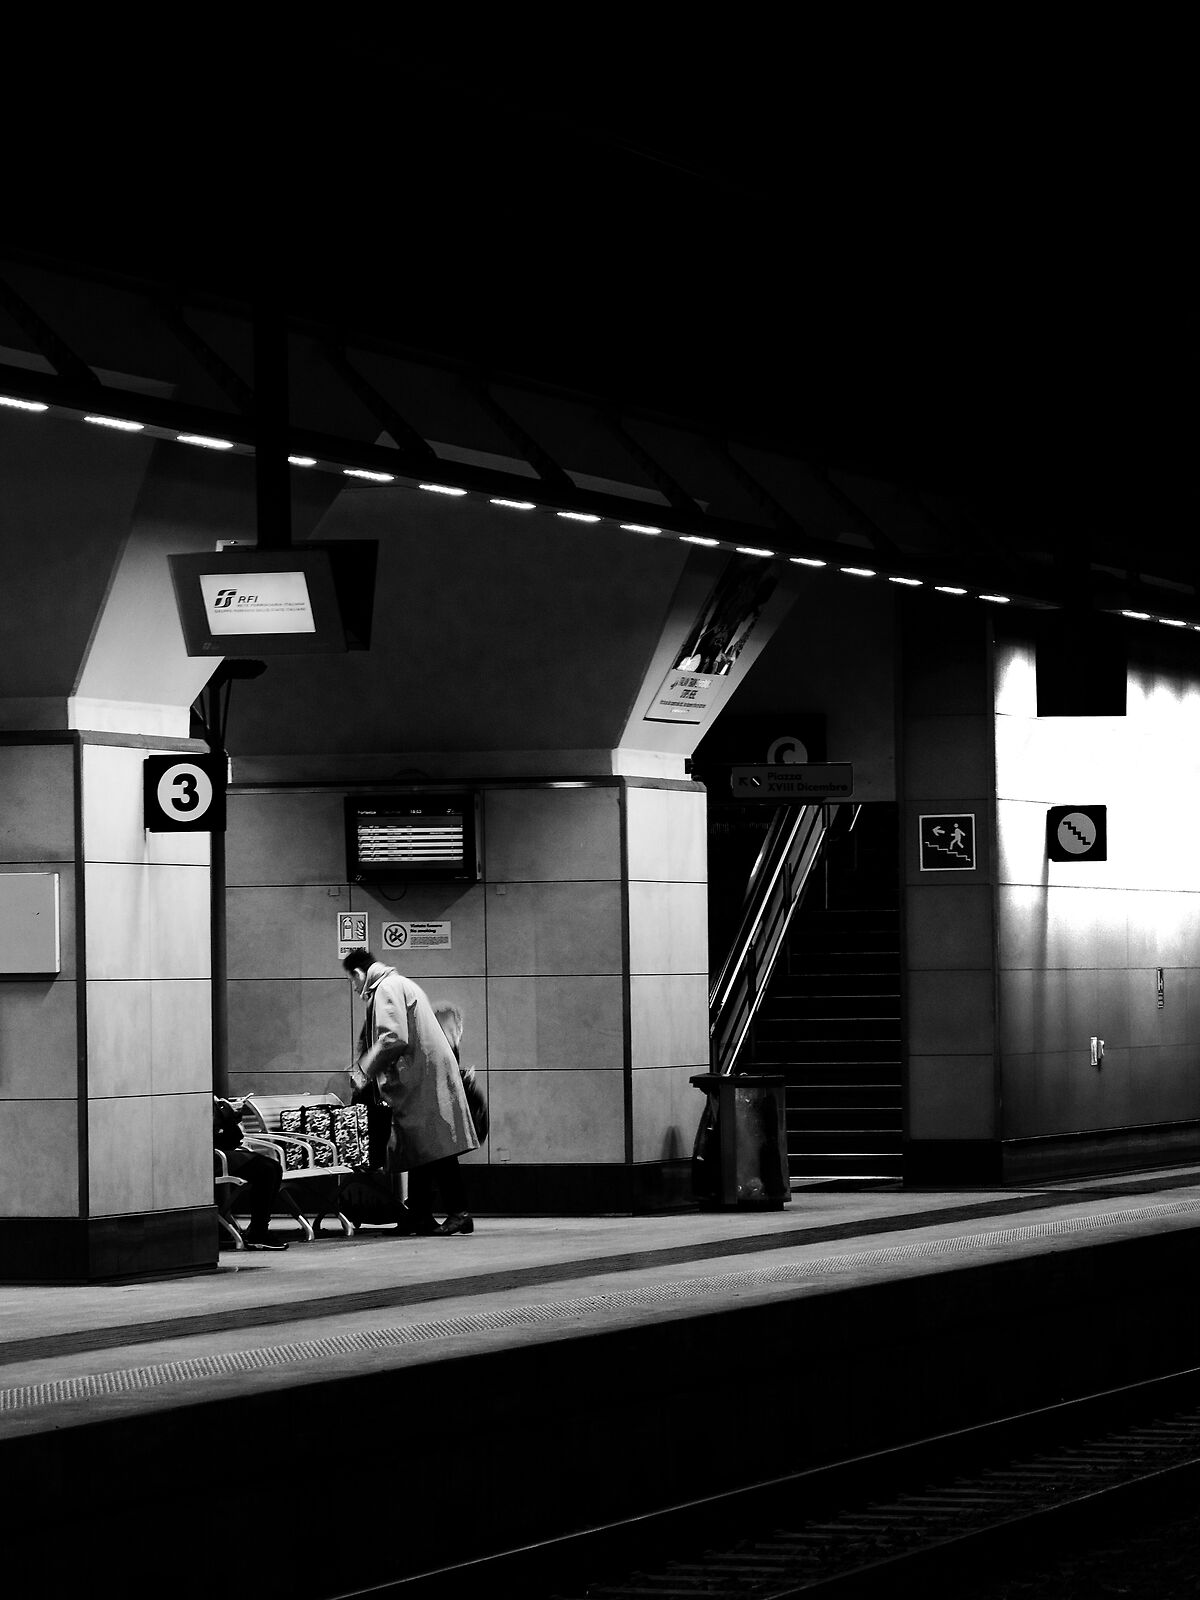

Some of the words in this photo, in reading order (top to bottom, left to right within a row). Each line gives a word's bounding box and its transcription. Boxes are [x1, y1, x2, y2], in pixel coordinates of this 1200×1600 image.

[238, 595, 259, 604] RFI
[767, 772, 802, 781] Piazza
[767, 782, 794, 792] XVIII
[797, 782, 848, 792] Dicembre
[171, 773, 200, 812] 3
